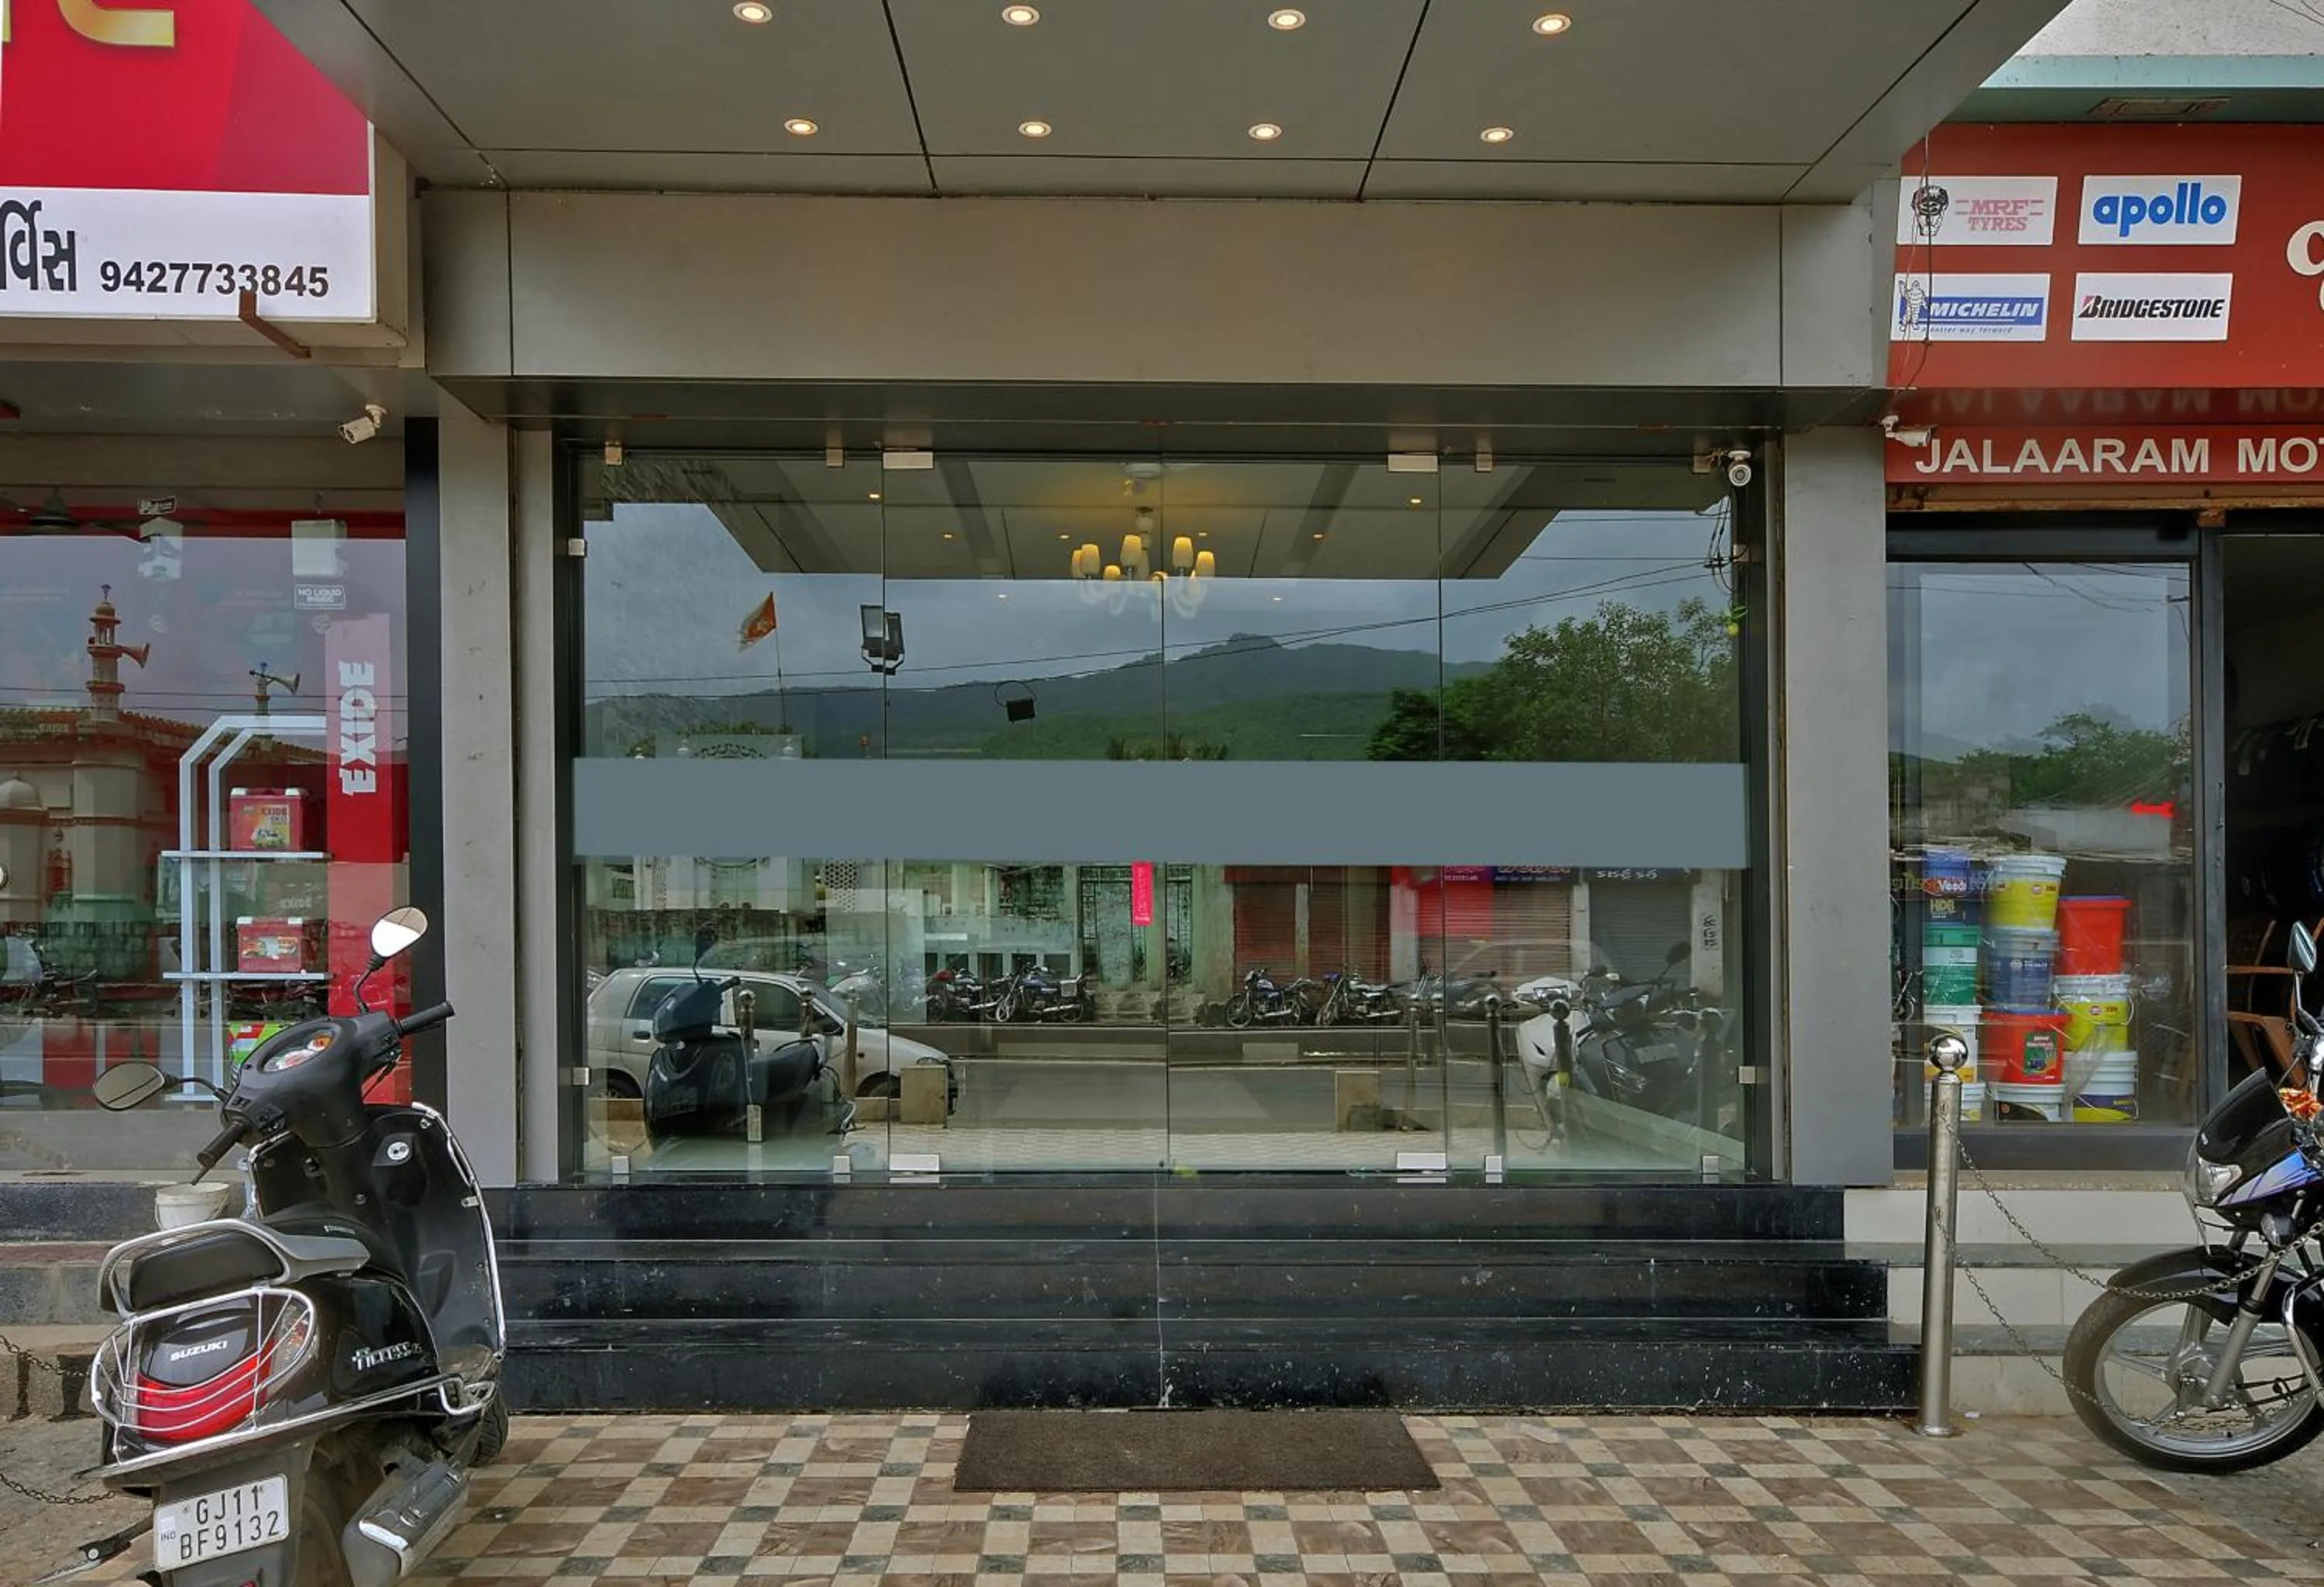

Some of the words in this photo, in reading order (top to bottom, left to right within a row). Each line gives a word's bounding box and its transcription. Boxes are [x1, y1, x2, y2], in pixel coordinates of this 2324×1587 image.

[1970, 199, 2029, 215] MRF
[2092, 183, 2227, 237] apollo
[1968, 216, 2027, 231] TYRES
[101, 261, 329, 298] 9427733845
[1930, 303, 2039, 317] MICHELIN
[2078, 294, 2225, 318] BRIDGESTONE
[1916, 437, 2209, 474] JALAARAM
[339, 660, 376, 796] EXIDE
[170, 1341, 229, 1362] SUZUKI
[196, 1485, 259, 1525] GJ11
[160, 1530, 176, 1542] IND
[180, 1510, 280, 1560] BF9132
